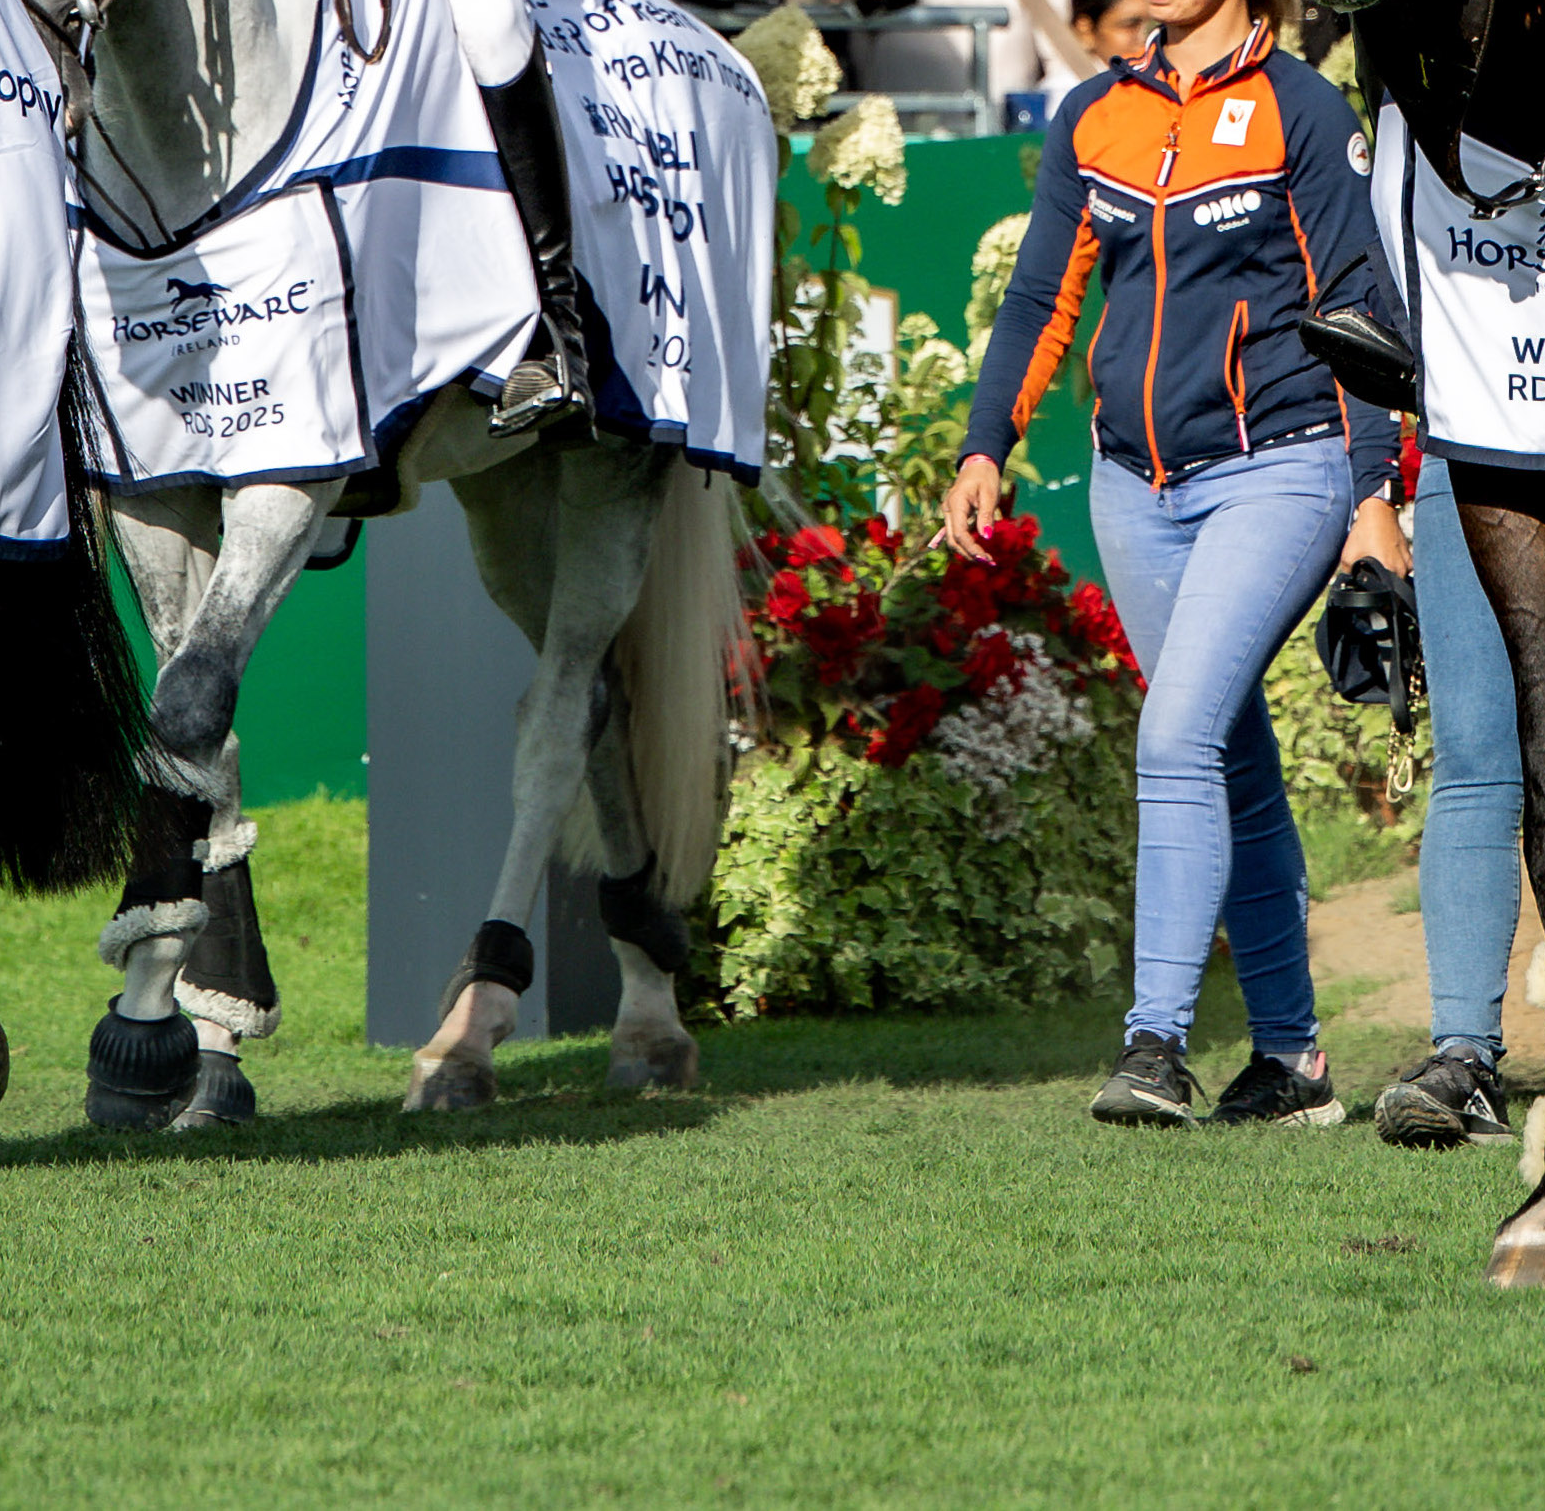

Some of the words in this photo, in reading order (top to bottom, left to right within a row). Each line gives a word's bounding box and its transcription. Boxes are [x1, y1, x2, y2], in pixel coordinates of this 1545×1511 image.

[649, 39, 713, 83] Khan
[111, 281, 311, 343] HORSEWARE
[170, 334, 241, 357] IRELAND
[169, 378, 271, 407] WINNER
[181, 411, 215, 438] RDS
[220, 403, 285, 439] 2025
